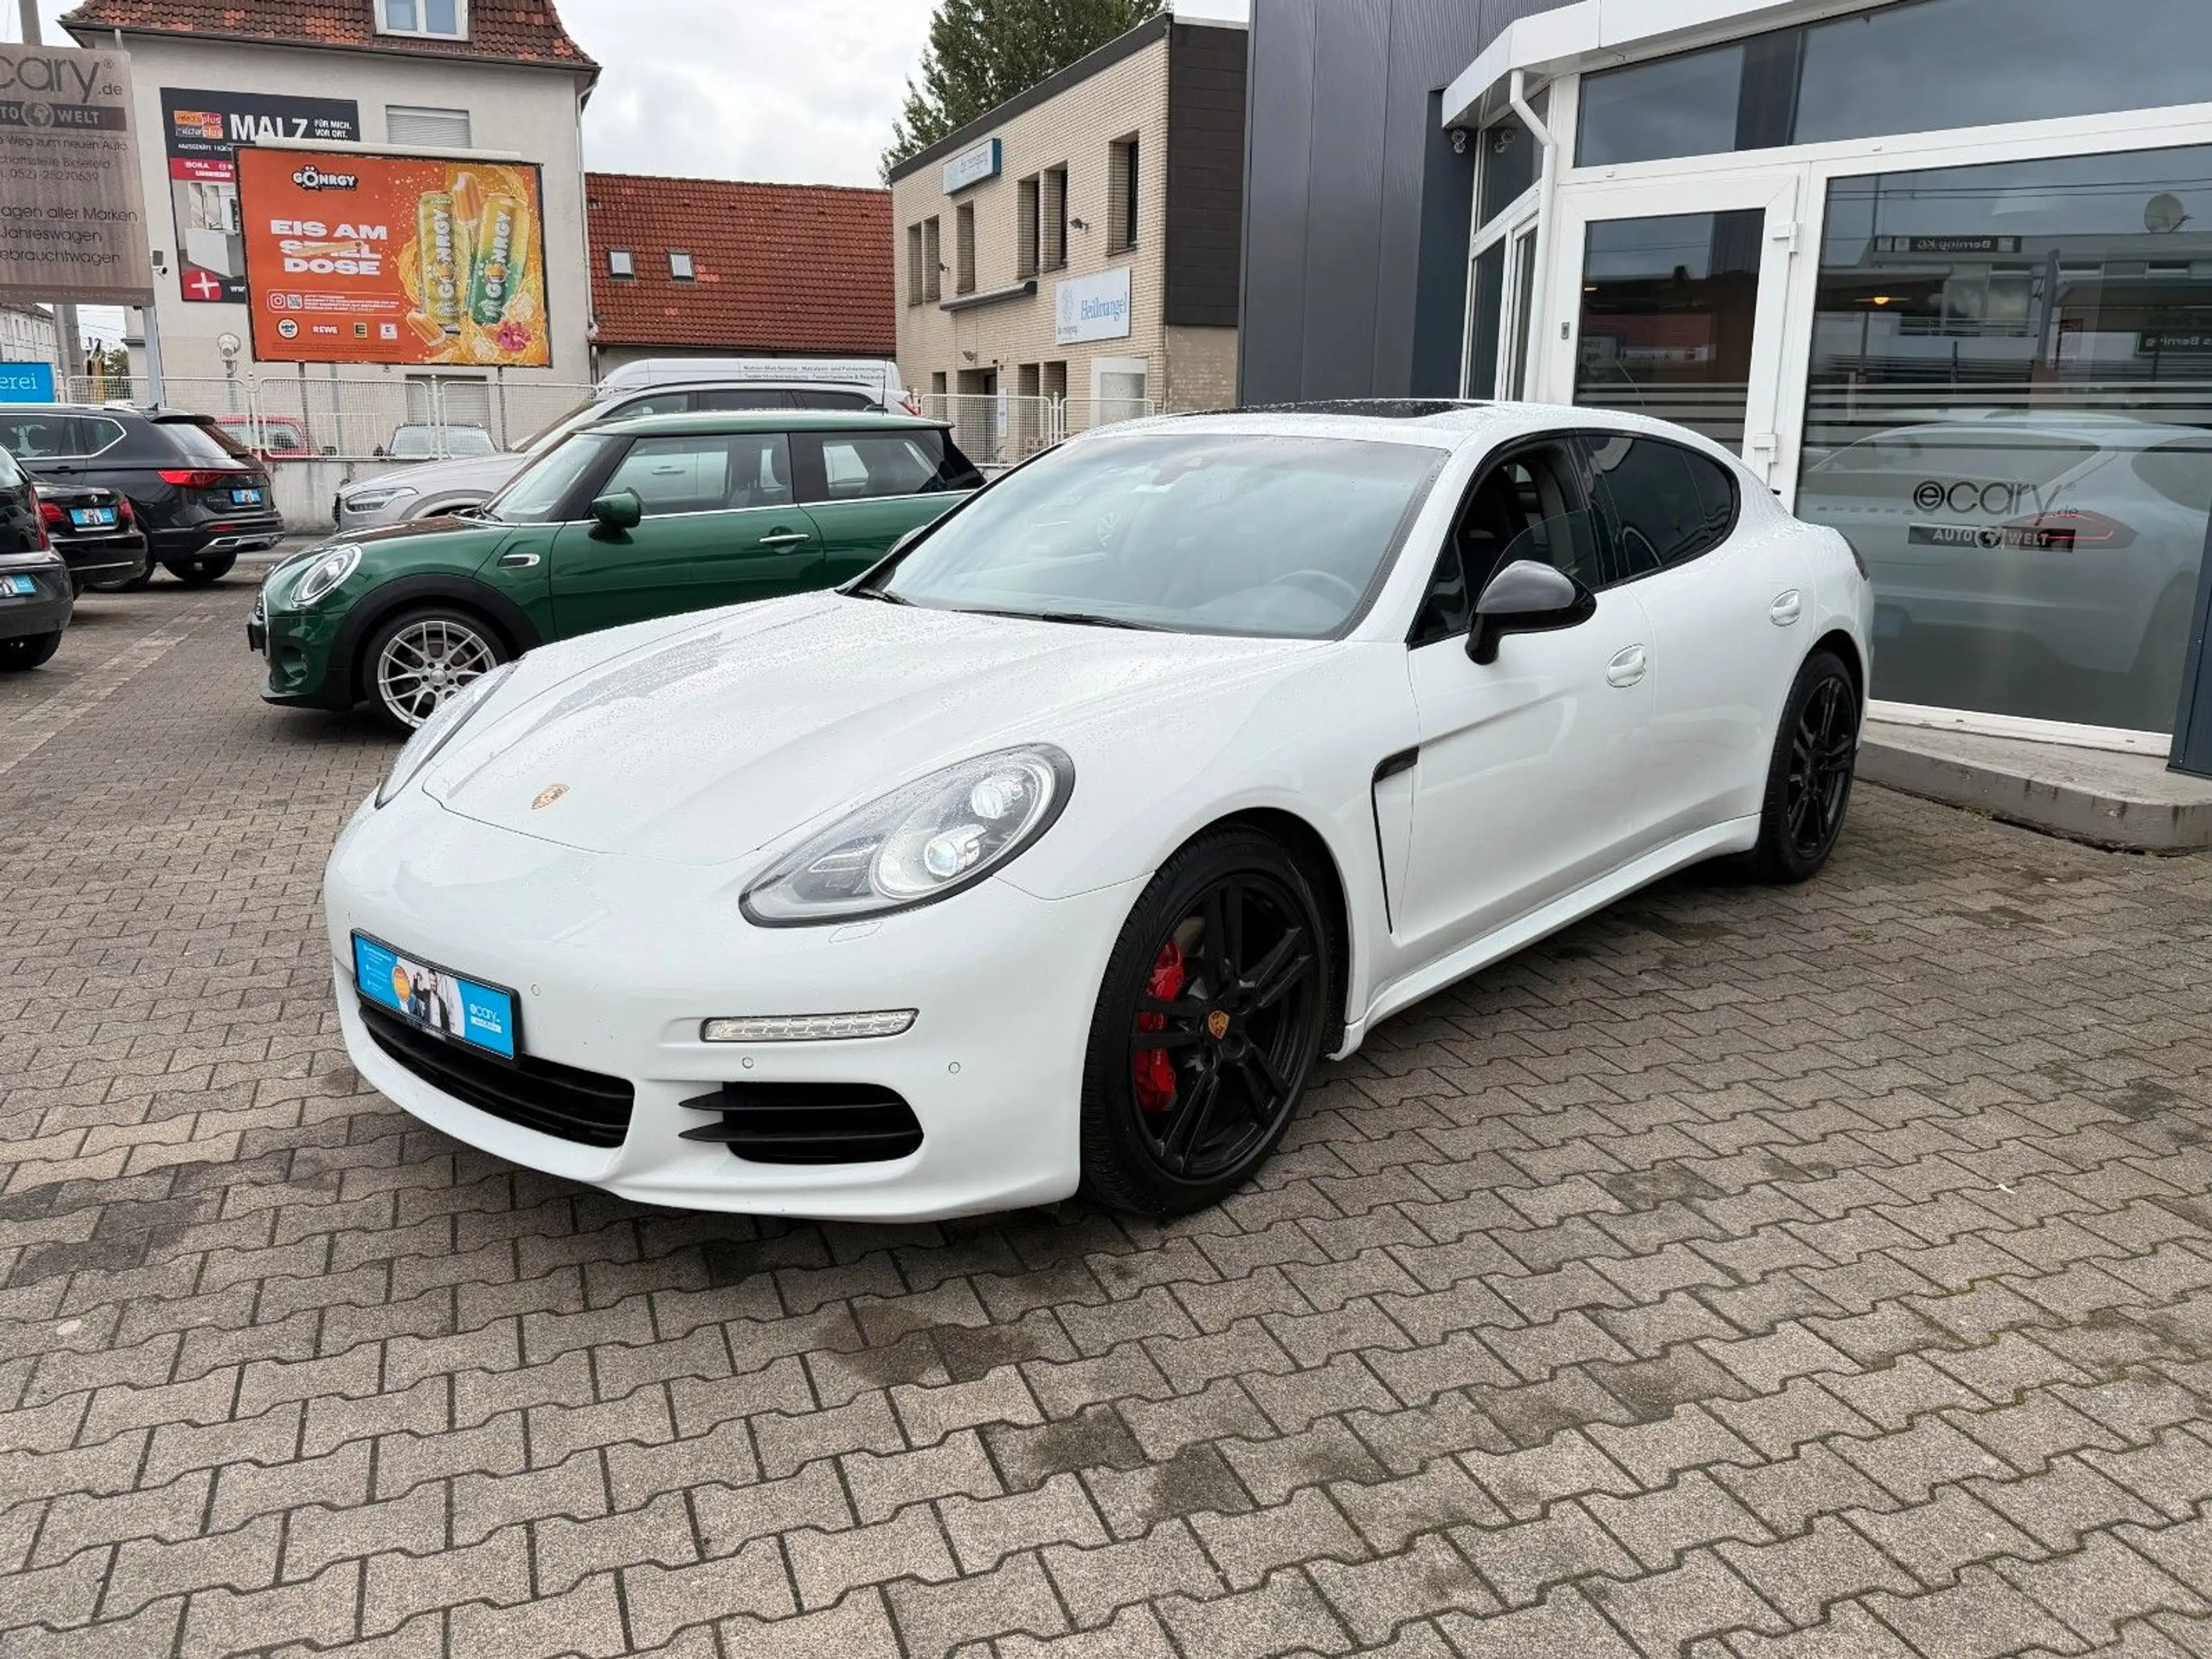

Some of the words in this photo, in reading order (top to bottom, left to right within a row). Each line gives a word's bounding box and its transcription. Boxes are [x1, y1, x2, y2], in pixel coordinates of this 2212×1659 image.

[99, 83, 123, 95] .de
[59, 109, 100, 124] WELT
[315, 128, 330, 137] VOR
[63, 140, 99, 150] neuen
[293, 166, 356, 186] GÖNRGY
[47, 207, 78, 219] aller
[83, 208, 138, 222] Marken
[1, 226, 102, 244] Jahreswagen
[271, 219, 328, 237] EIS
[333, 224, 388, 240] AM
[284, 258, 381, 275] DOSE
[312, 325, 338, 334] REWE
[1913, 480, 2062, 527] ecary
[1931, 528, 1973, 542] AUTO
[2008, 532, 2050, 546] WELT
